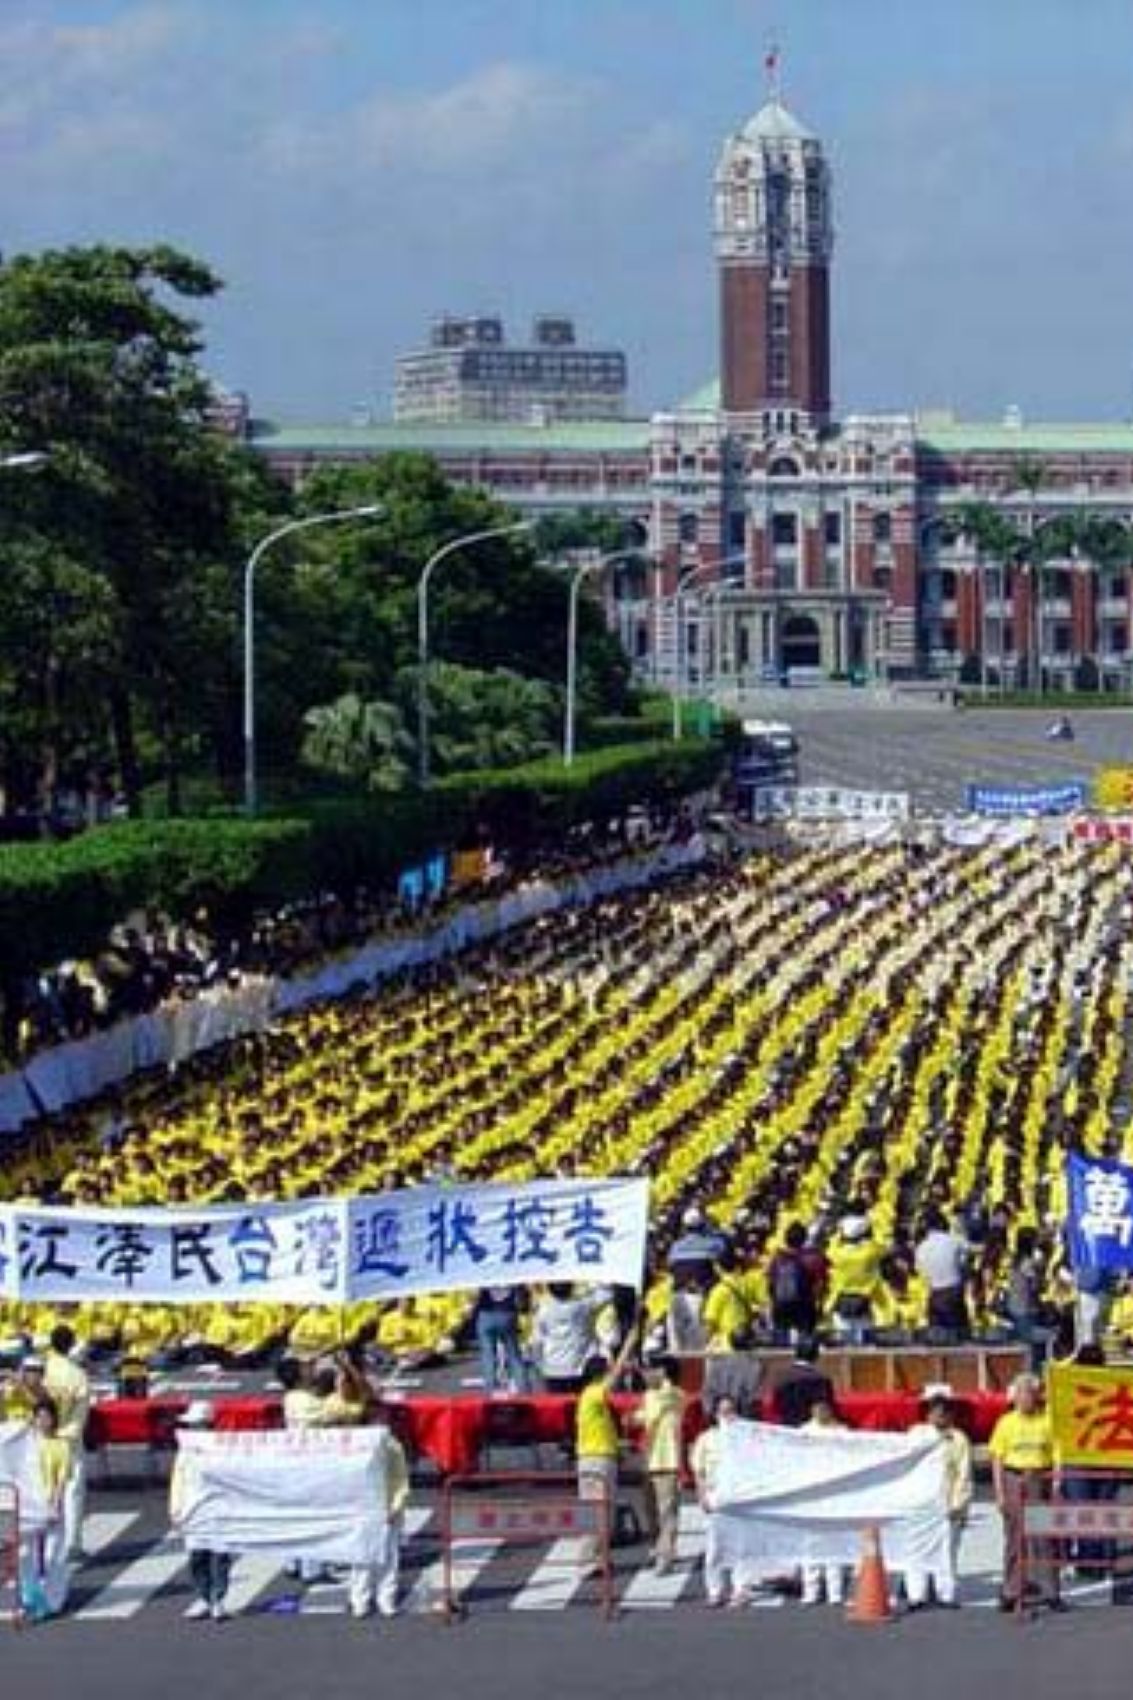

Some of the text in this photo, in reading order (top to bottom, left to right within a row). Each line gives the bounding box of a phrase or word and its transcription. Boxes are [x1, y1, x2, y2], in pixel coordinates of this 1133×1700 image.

[0, 1195, 613, 1290] 江澤民台灣遞狀控告
